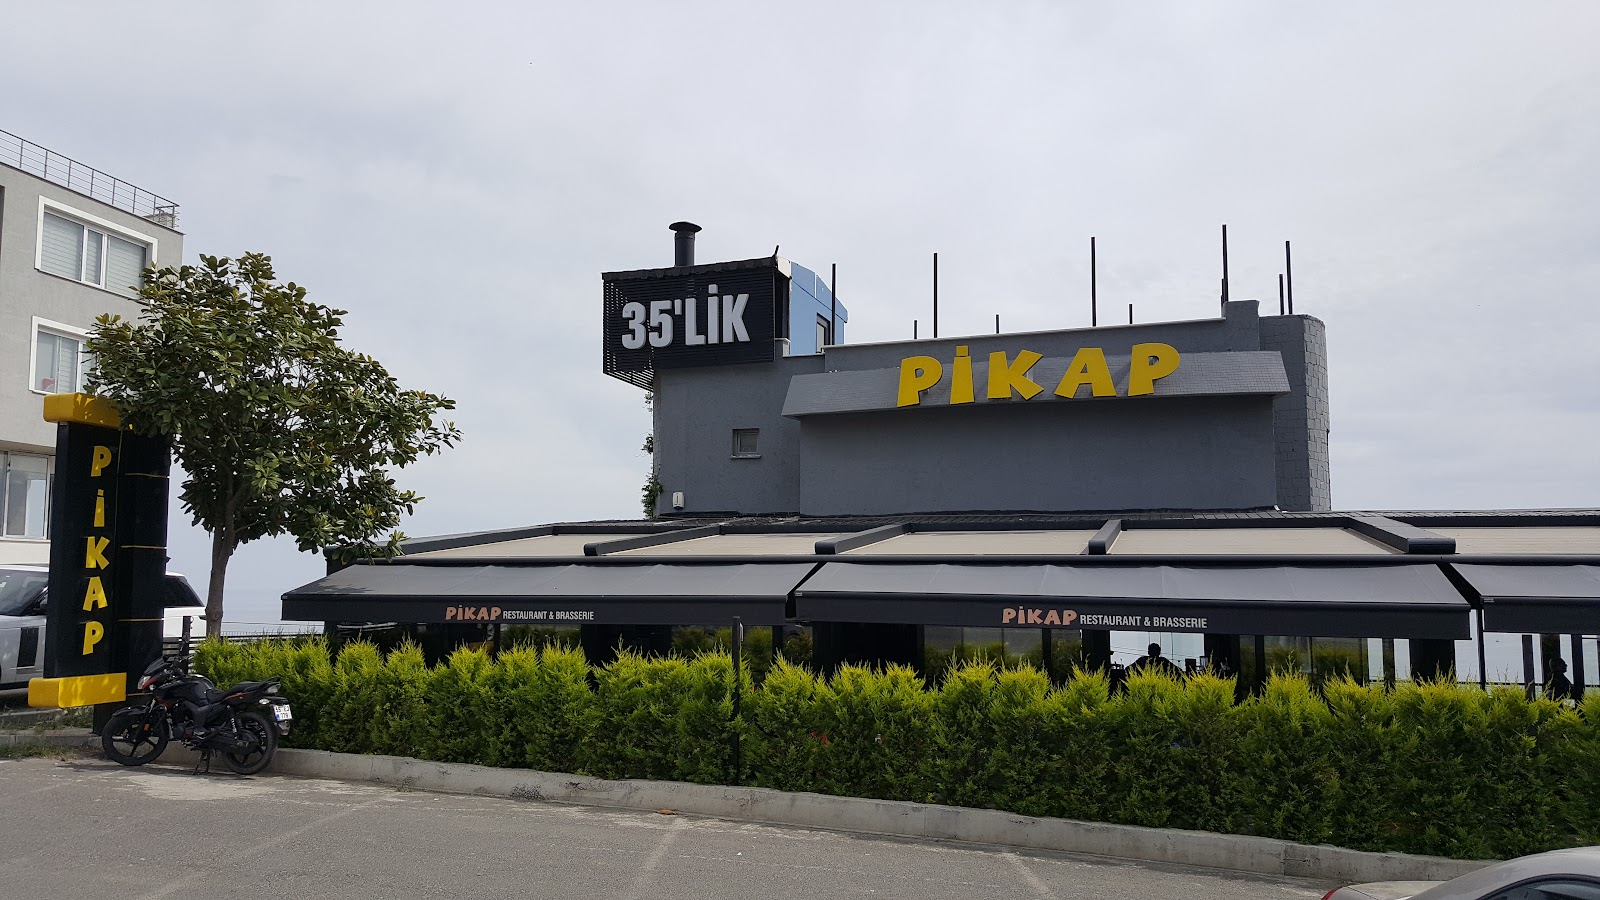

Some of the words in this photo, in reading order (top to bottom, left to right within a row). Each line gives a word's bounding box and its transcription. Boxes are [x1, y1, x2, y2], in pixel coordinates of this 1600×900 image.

[502, 610, 547, 620] RESTAURANT
[549, 611, 554, 620] &
[555, 611, 594, 620] BRASSERIE
[1080, 614, 1141, 626] RESTAURANT
[1144, 617, 1151, 626] &
[1153, 617, 1207, 628] BRASSERIE
